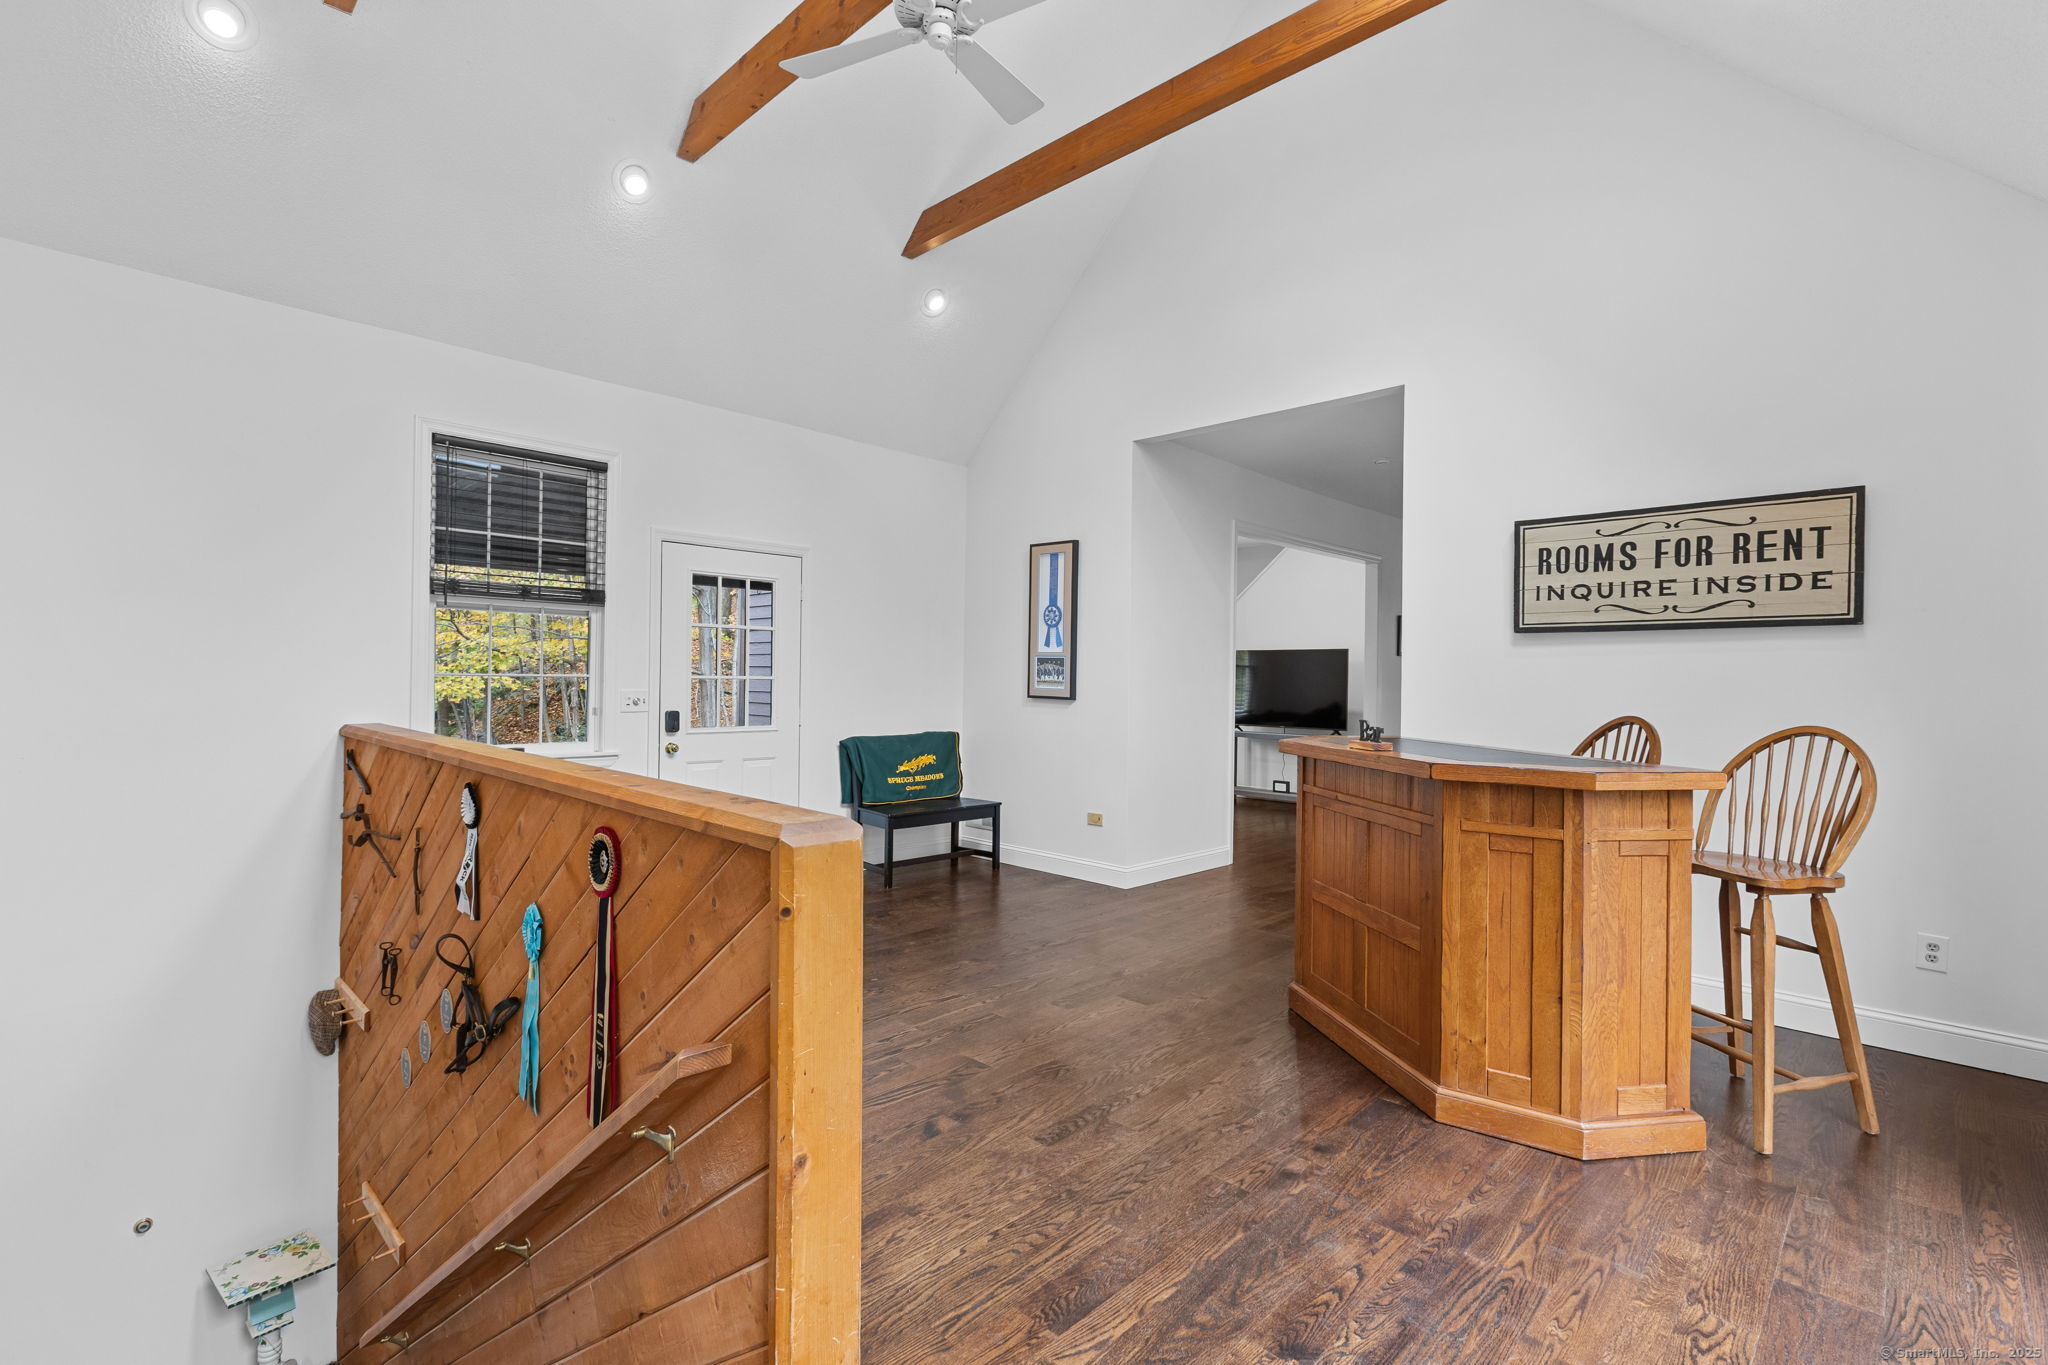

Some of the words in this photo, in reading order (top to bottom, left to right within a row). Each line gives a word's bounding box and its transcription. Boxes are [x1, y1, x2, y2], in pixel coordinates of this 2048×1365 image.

[1537, 540, 1638, 575] ROOMS
[1654, 535, 1714, 569] FOR
[1732, 525, 1832, 566] RENT
[1535, 578, 1678, 601] INQUIRE
[1692, 570, 1833, 595] INSIDE
[1359, 720, 1384, 743] Bar
[887, 776, 914, 784] SPRUCE
[914, 773, 944, 782] MEADOWS
